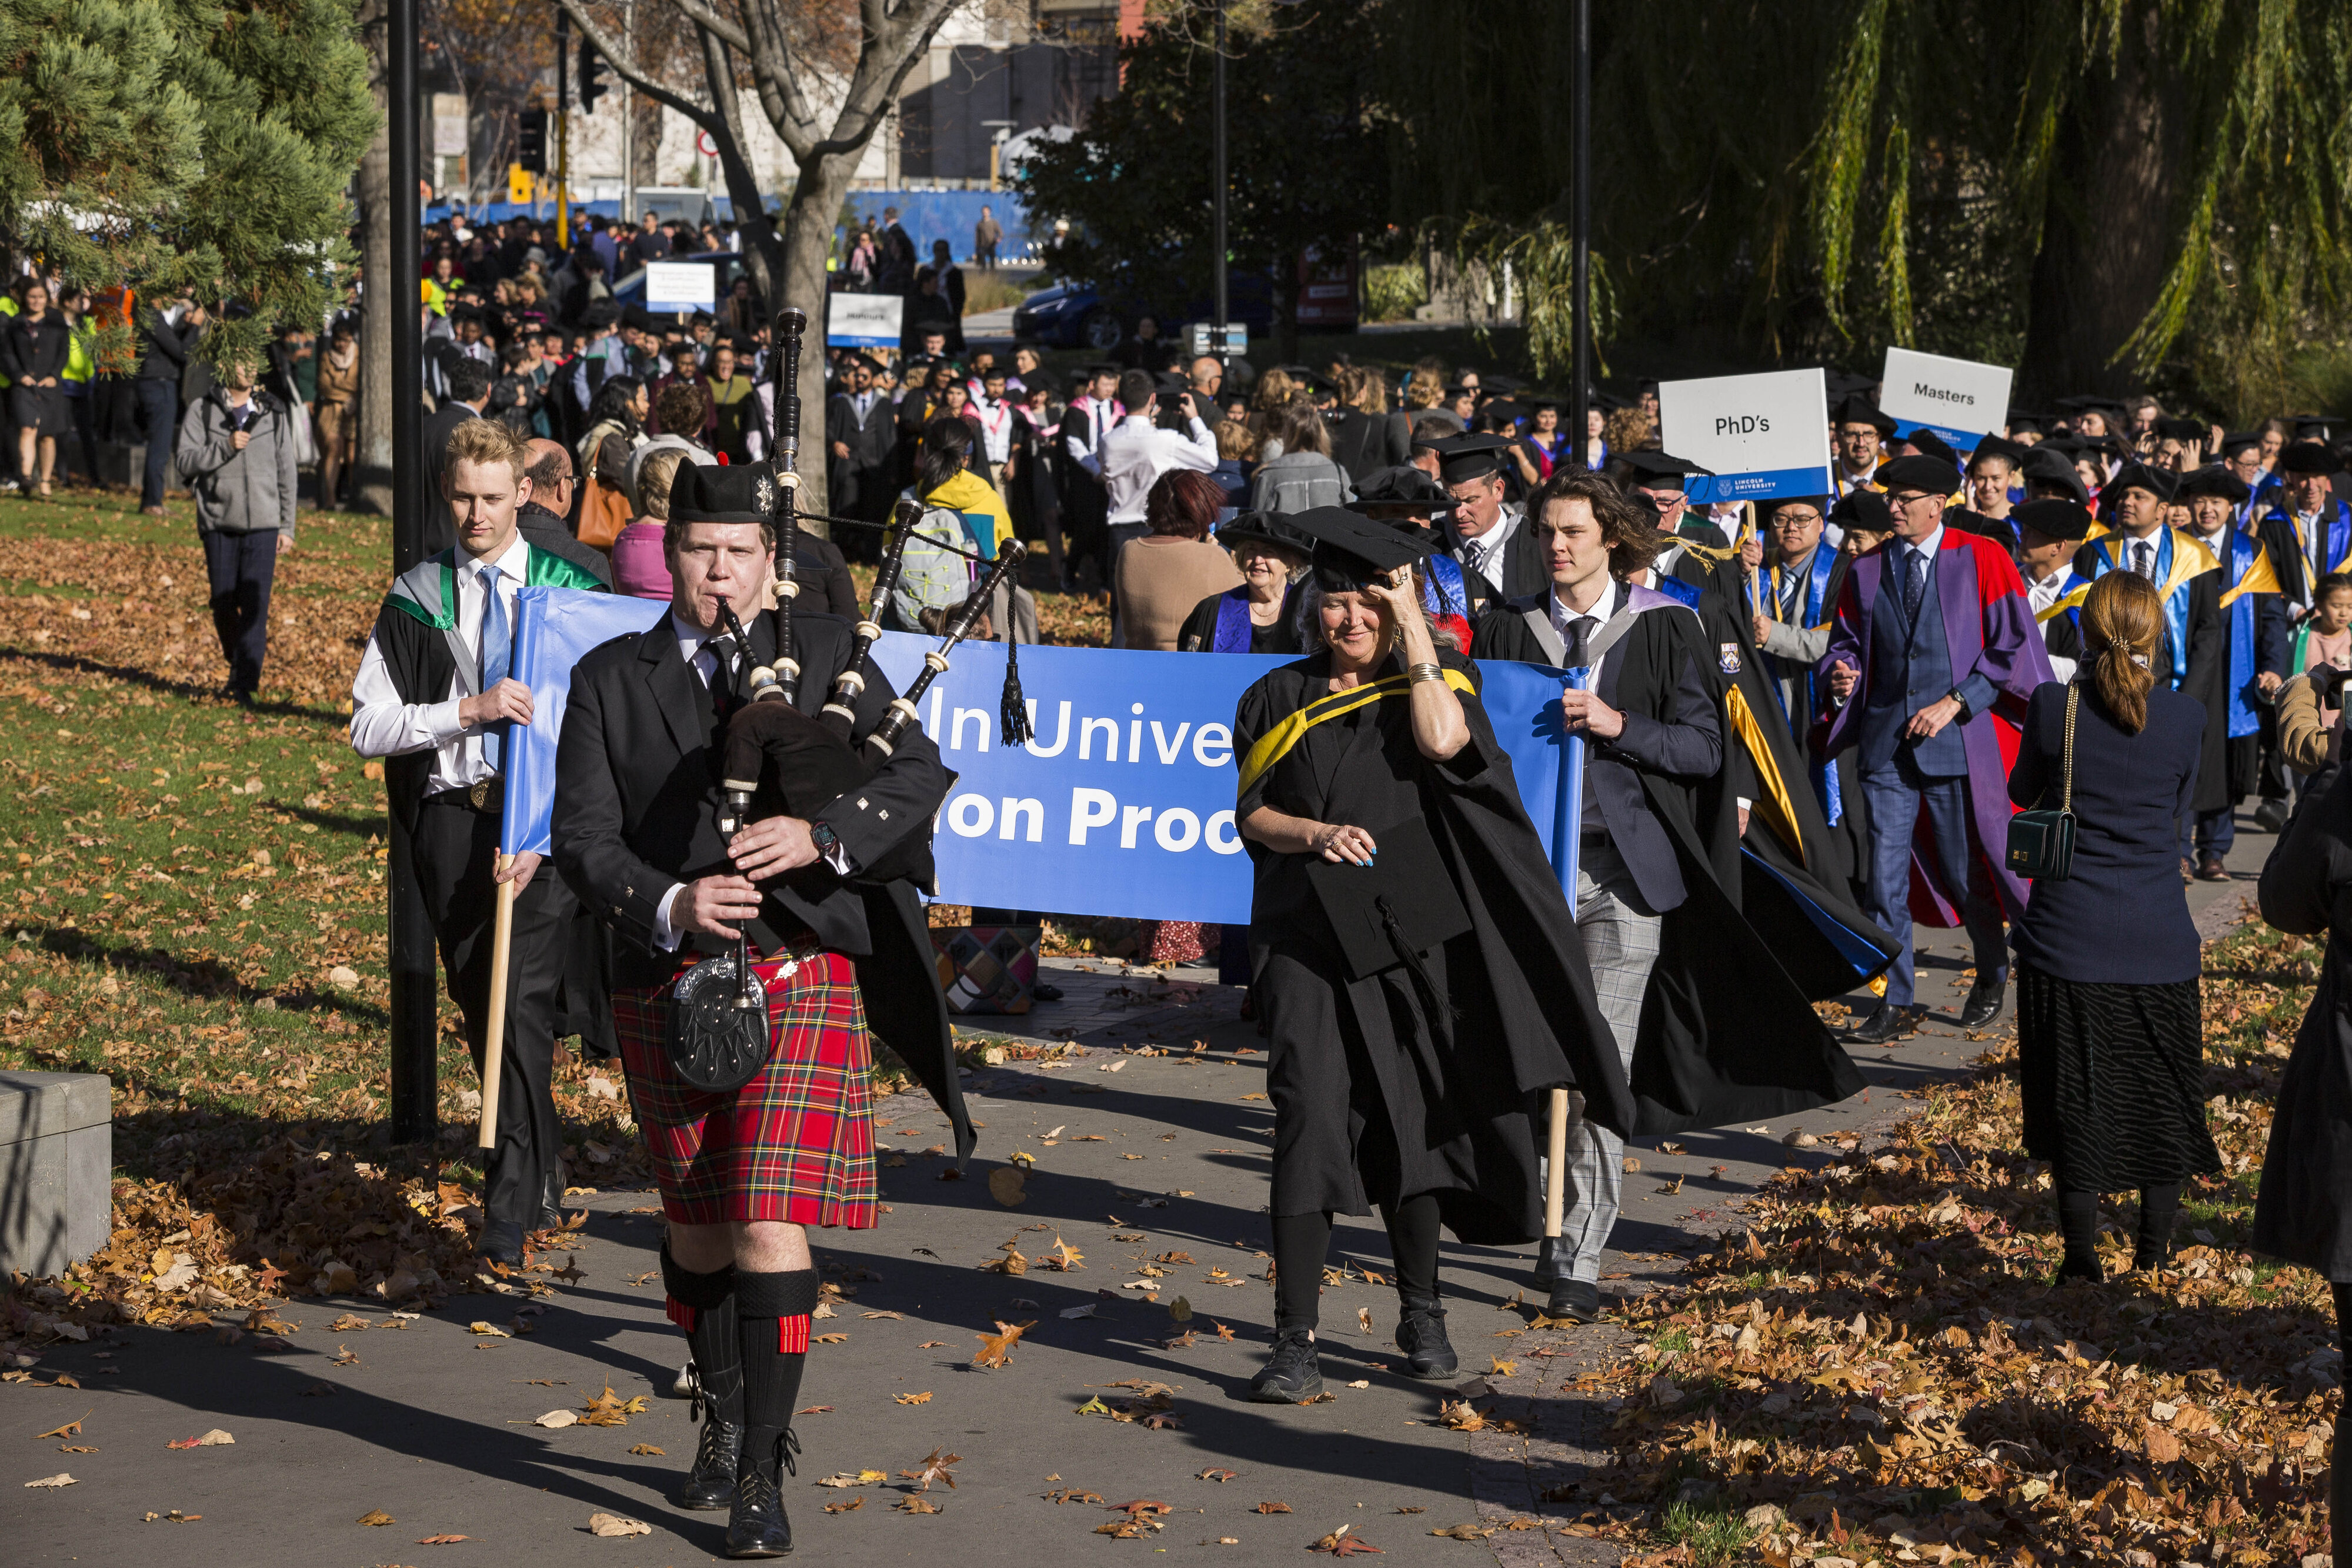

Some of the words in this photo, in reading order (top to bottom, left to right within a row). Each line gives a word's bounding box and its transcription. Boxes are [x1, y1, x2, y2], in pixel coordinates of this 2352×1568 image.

[1914, 382, 1974, 405] Masters
[1716, 415, 1769, 435] PhD's
[1735, 482, 1776, 490] UNIVERSITY
[1025, 698, 1233, 768] Unive
[1069, 787, 1244, 855] Proc
